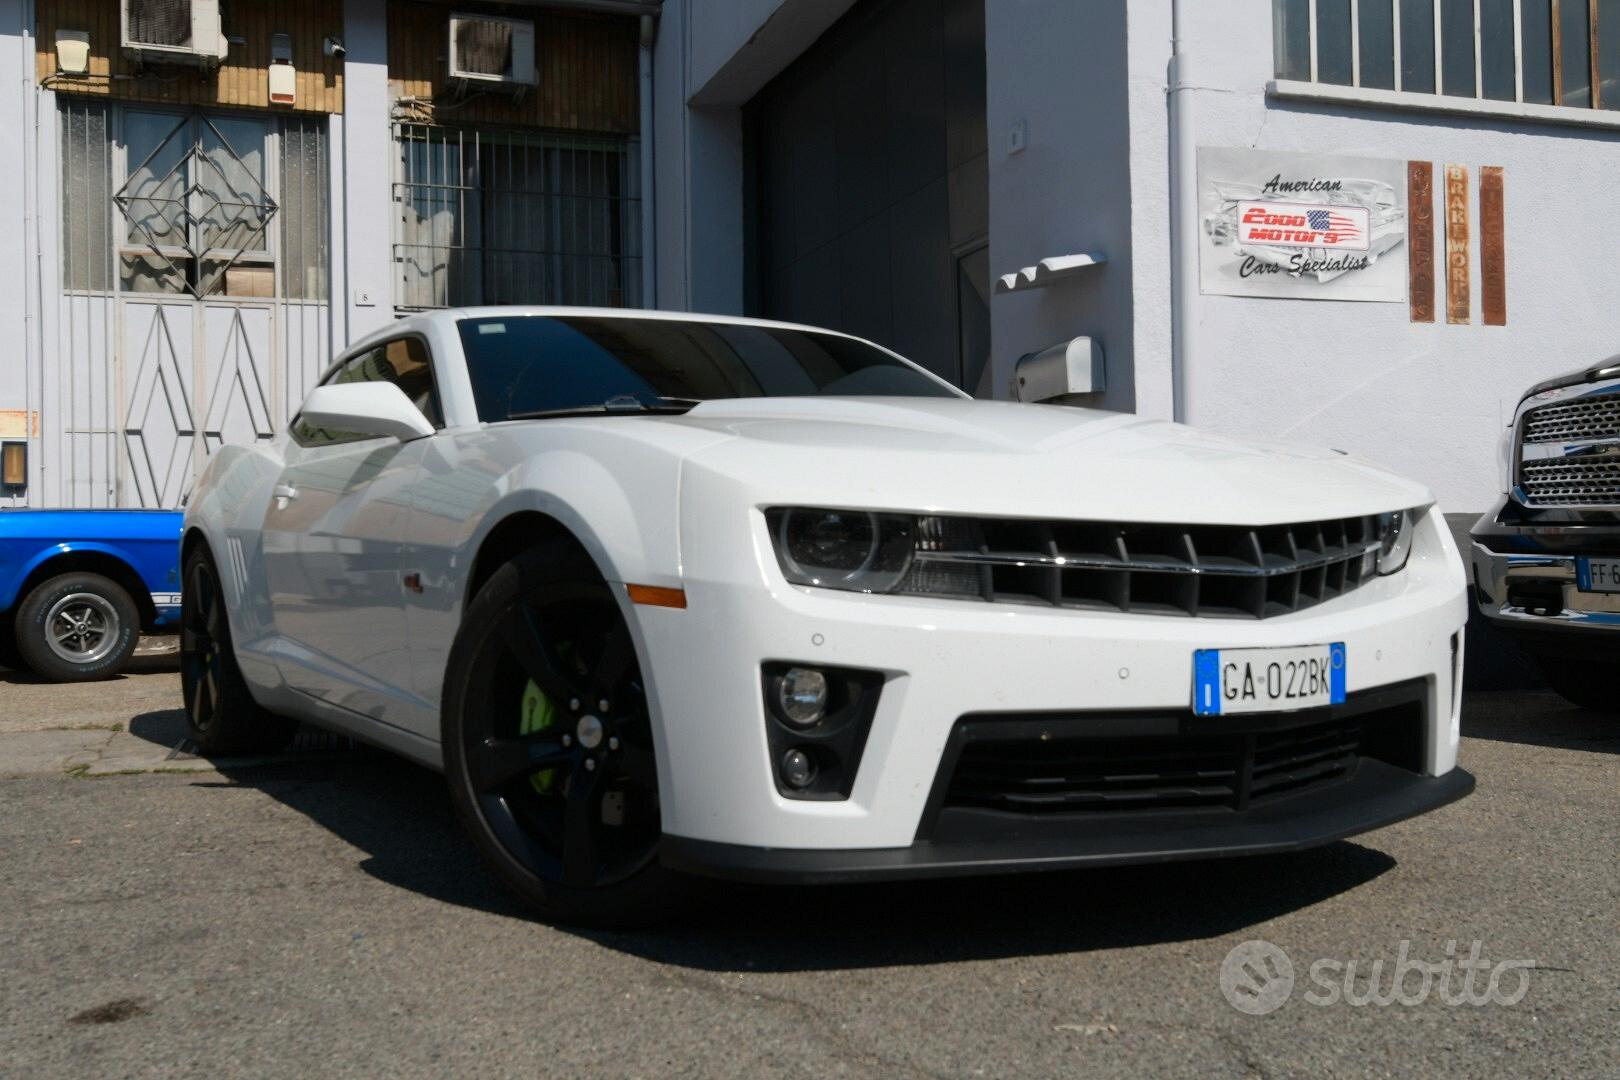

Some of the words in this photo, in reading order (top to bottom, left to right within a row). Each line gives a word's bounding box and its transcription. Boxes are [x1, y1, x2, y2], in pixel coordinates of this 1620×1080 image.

[1262, 174, 1342, 194] American
[1243, 208, 1306, 226] 2000
[1240, 255, 1280, 278] Cars
[1288, 254, 1368, 277] Specialist
[1590, 563, 1607, 584] FF
[1223, 662, 1256, 700] GA
[1266, 657, 1330, 699] 022BK
